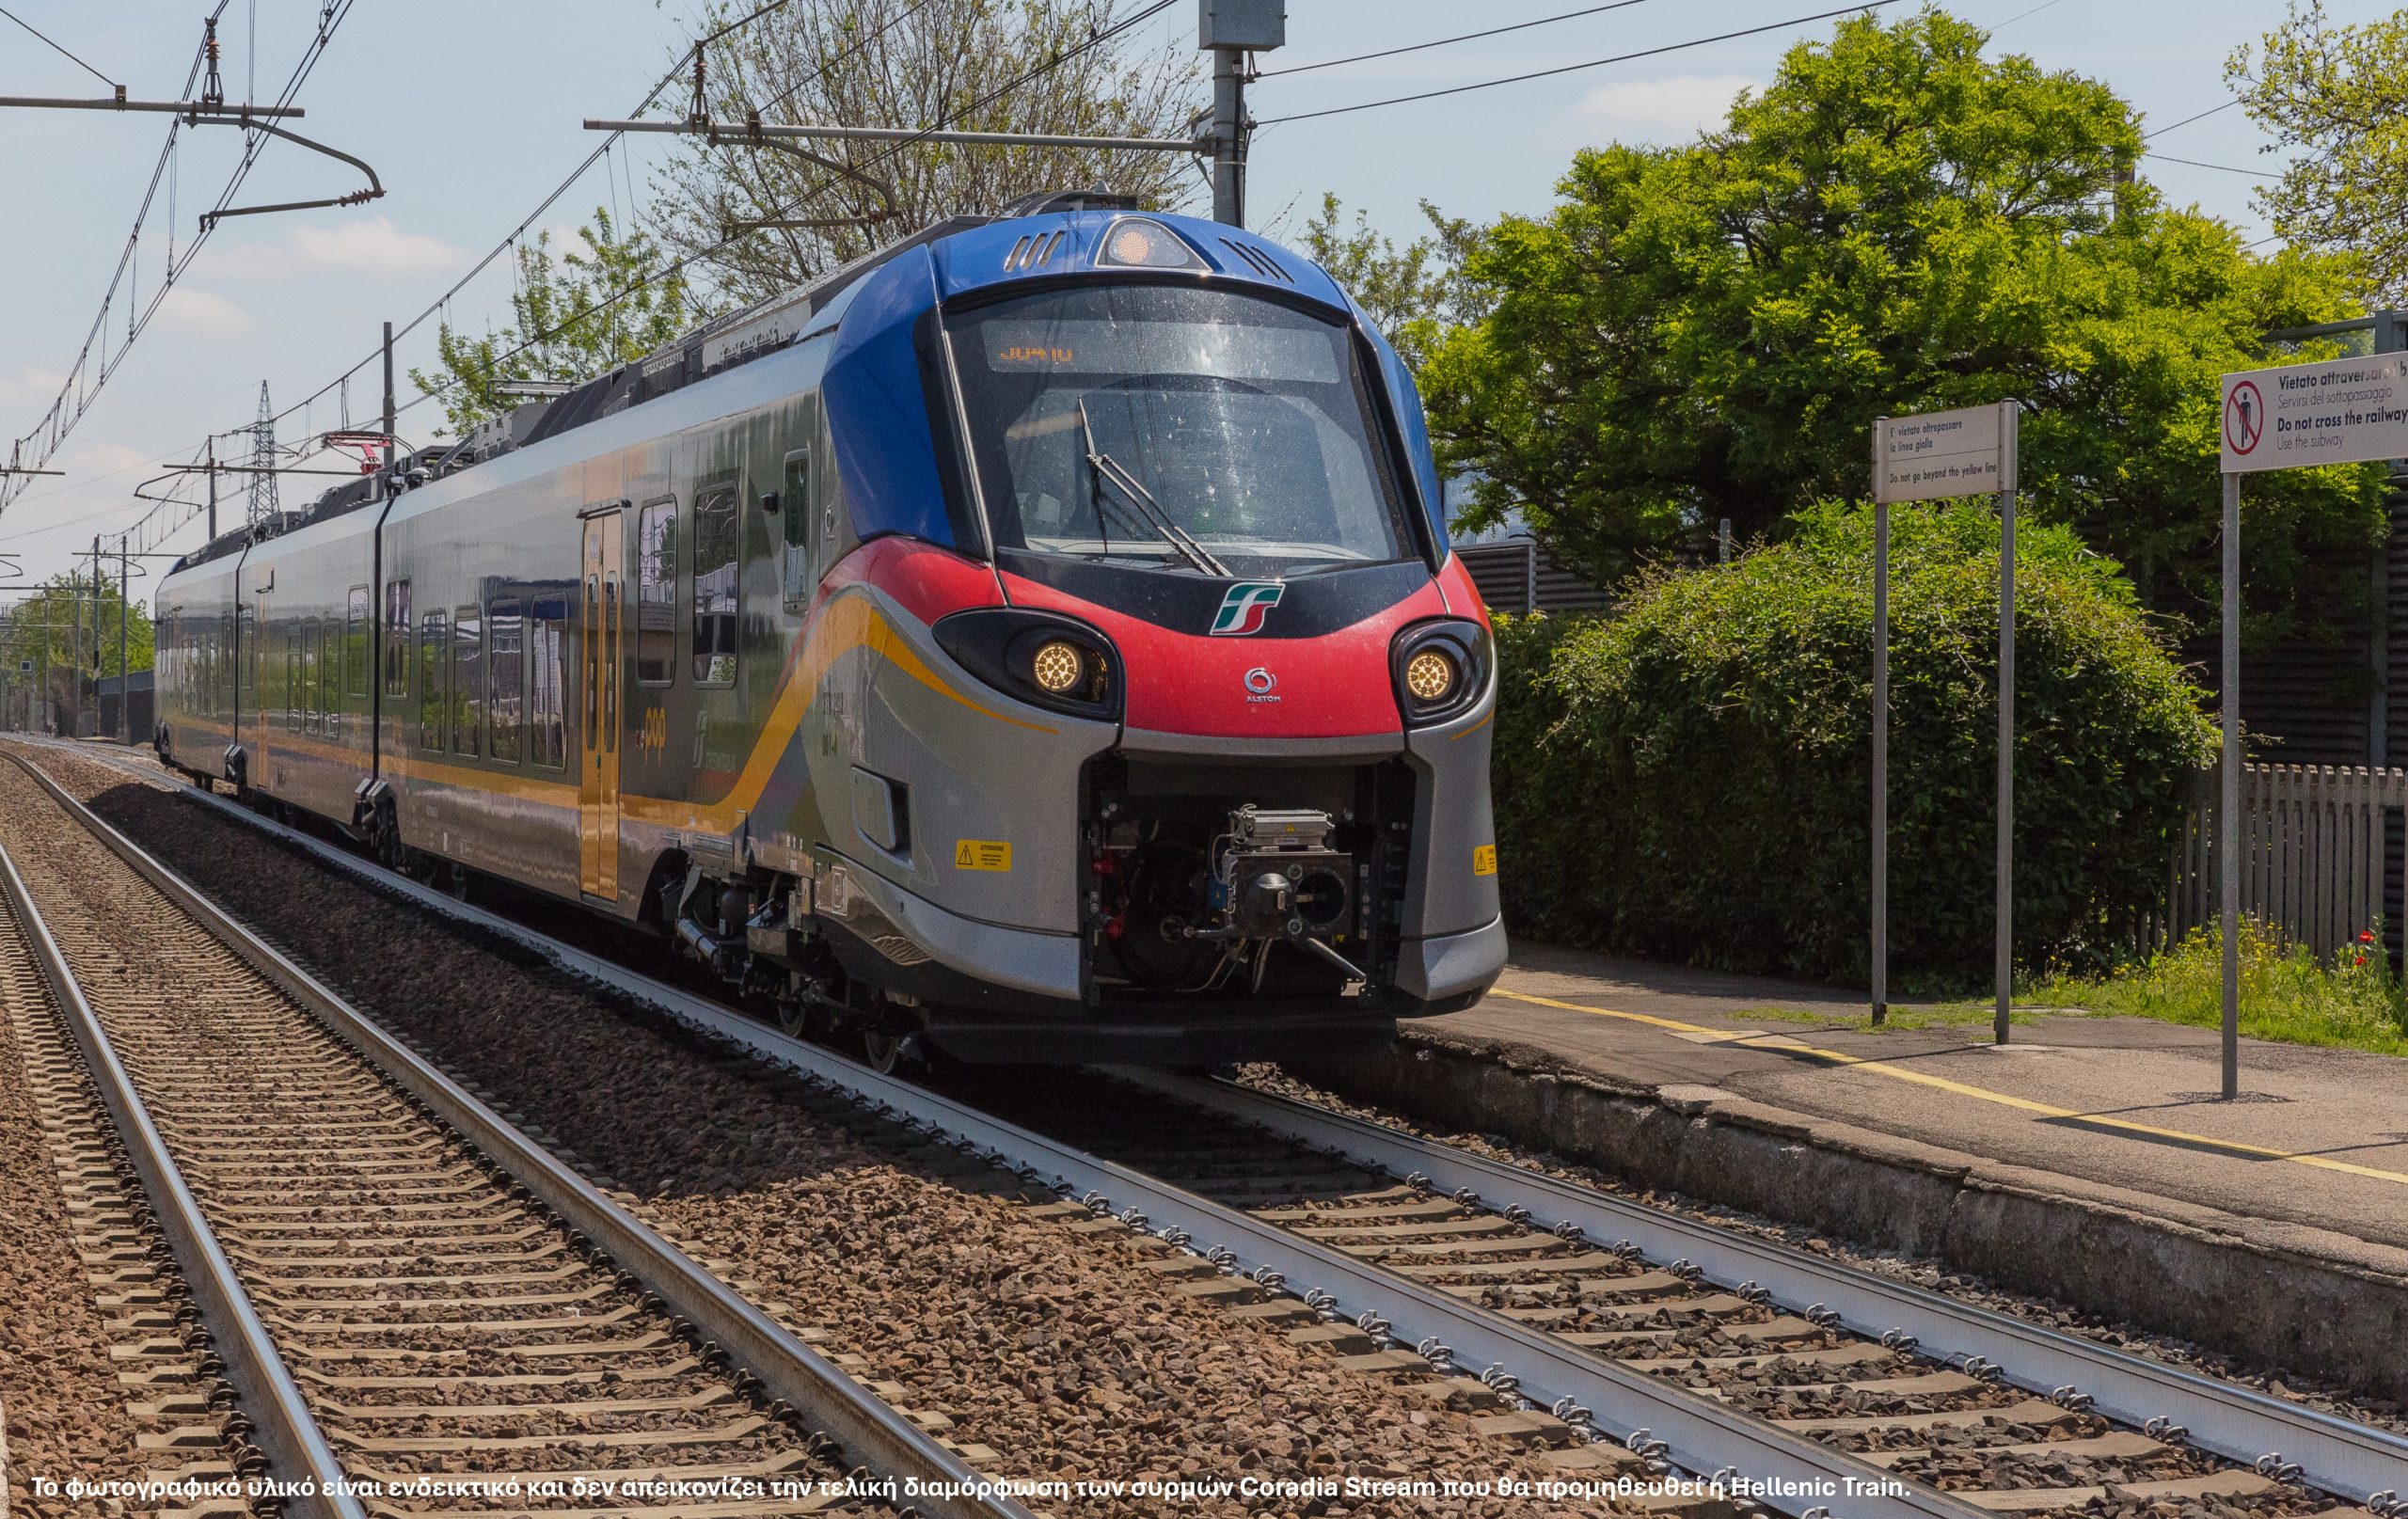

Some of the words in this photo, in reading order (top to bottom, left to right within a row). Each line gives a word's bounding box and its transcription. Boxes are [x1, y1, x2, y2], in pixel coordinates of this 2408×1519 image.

[2279, 374, 2318, 390] Vietato
[2278, 392, 2307, 409] Servirsi
[2310, 389, 2324, 405] del
[2326, 385, 2393, 406] sottopassaggio
[1898, 425, 1921, 436] vietato
[1923, 420, 1963, 434] oltrepassare
[2277, 417, 2292, 432] Do
[2295, 417, 2312, 430] not
[2315, 416, 2342, 429] cross
[2345, 409, 2362, 425] the
[2366, 406, 2408, 424] railway
[1890, 442, 1896, 452] la
[1898, 441, 1913, 451] linea
[1915, 437, 1933, 452] gialla
[2277, 434, 2292, 451] Use
[2295, 434, 2308, 450] the
[2311, 432, 2345, 449] subway
[1890, 473, 1898, 483] Do
[1900, 472, 1910, 483] not
[1912, 473, 1921, 483] go
[1923, 467, 1946, 482] beyond
[1948, 466, 1959, 477] the
[1961, 464, 1983, 478] yellow
[1985, 462, 1997, 473] line
